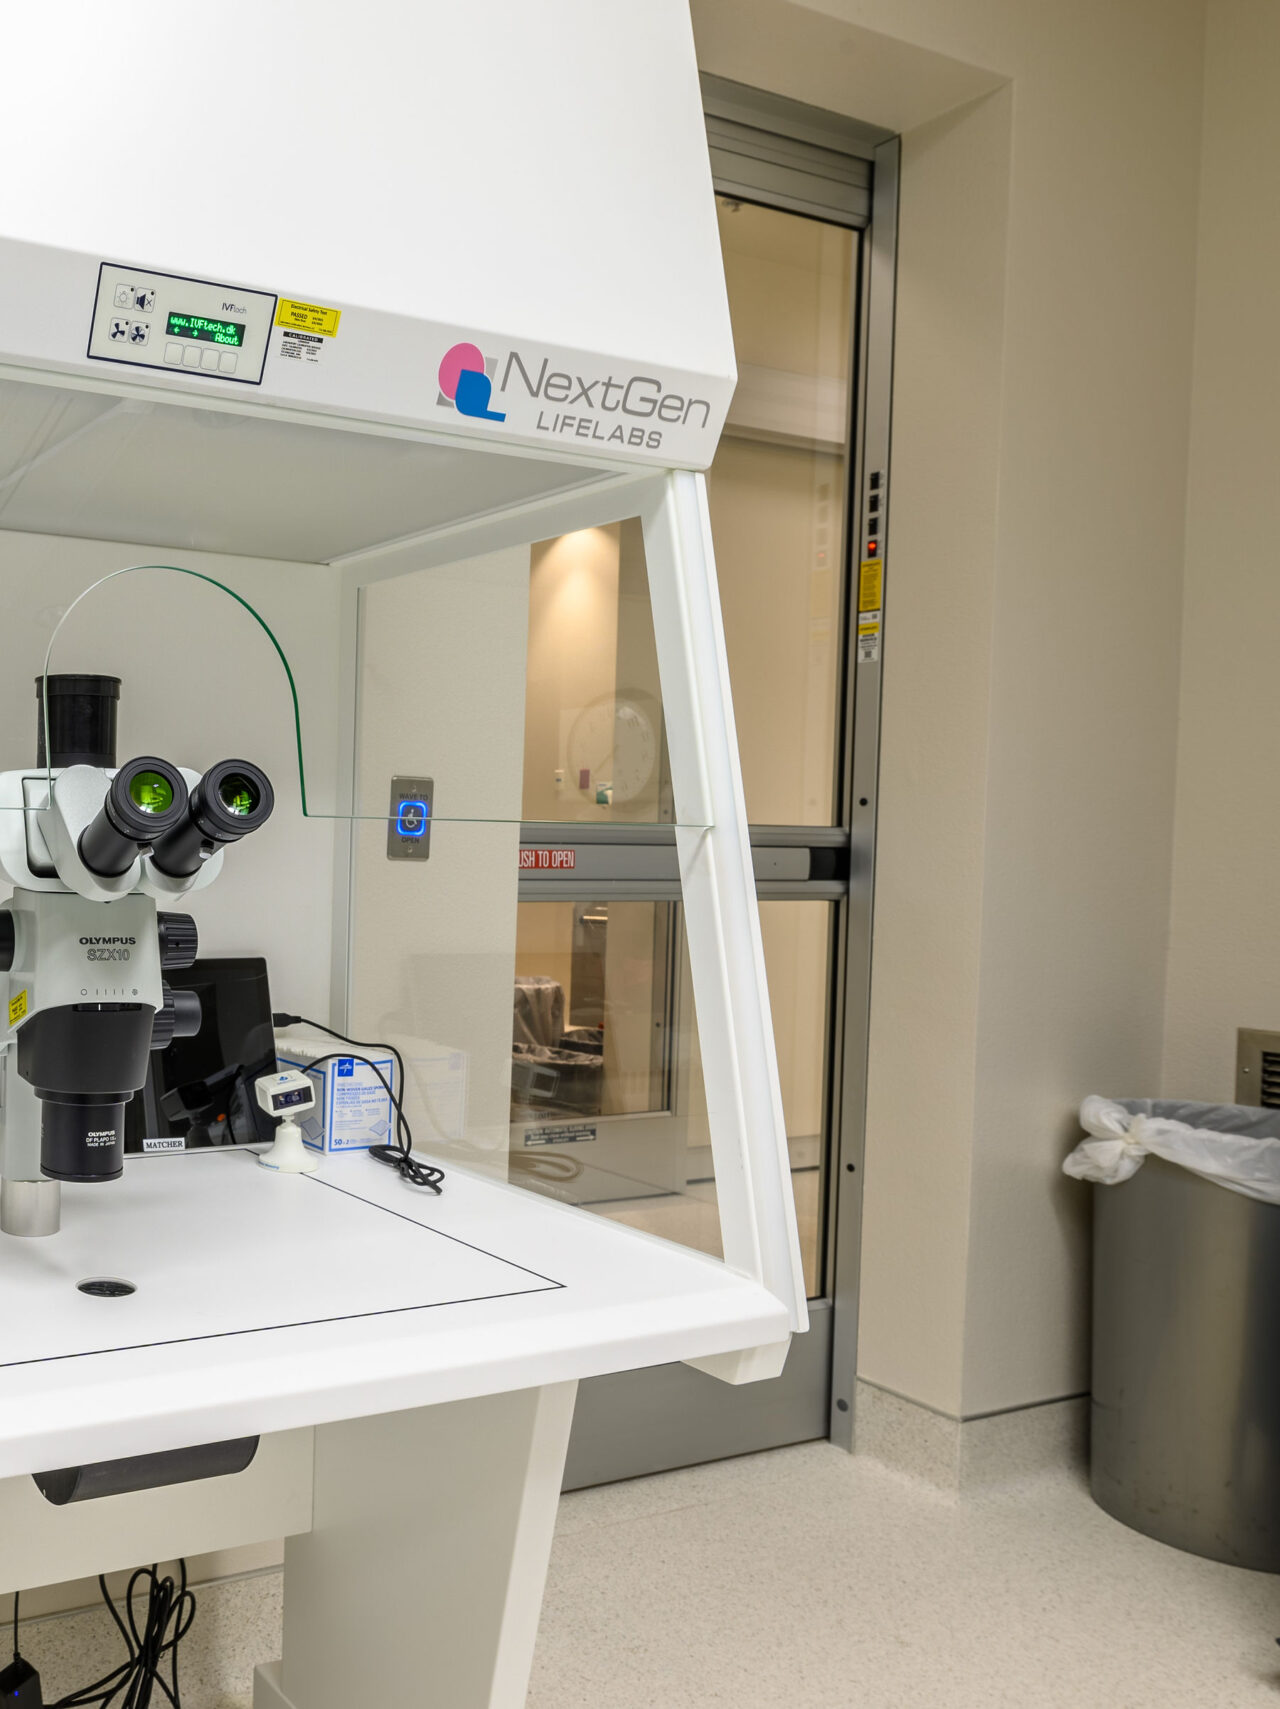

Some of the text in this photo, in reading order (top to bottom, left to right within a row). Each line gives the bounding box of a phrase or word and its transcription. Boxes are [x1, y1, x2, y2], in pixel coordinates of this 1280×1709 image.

[291, 311, 308, 320] PASSED
[170, 316, 236, 335] www.IVFtech.dk
[215, 332, 239, 345] About
[500, 351, 711, 428] NextGen
[536, 411, 663, 449] LIFELABS
[519, 850, 575, 867] USH TO OPEN
[79, 937, 136, 945] OLYMPUS
[87, 948, 131, 961] SZX10
[145, 1140, 183, 1149] MATCHER
